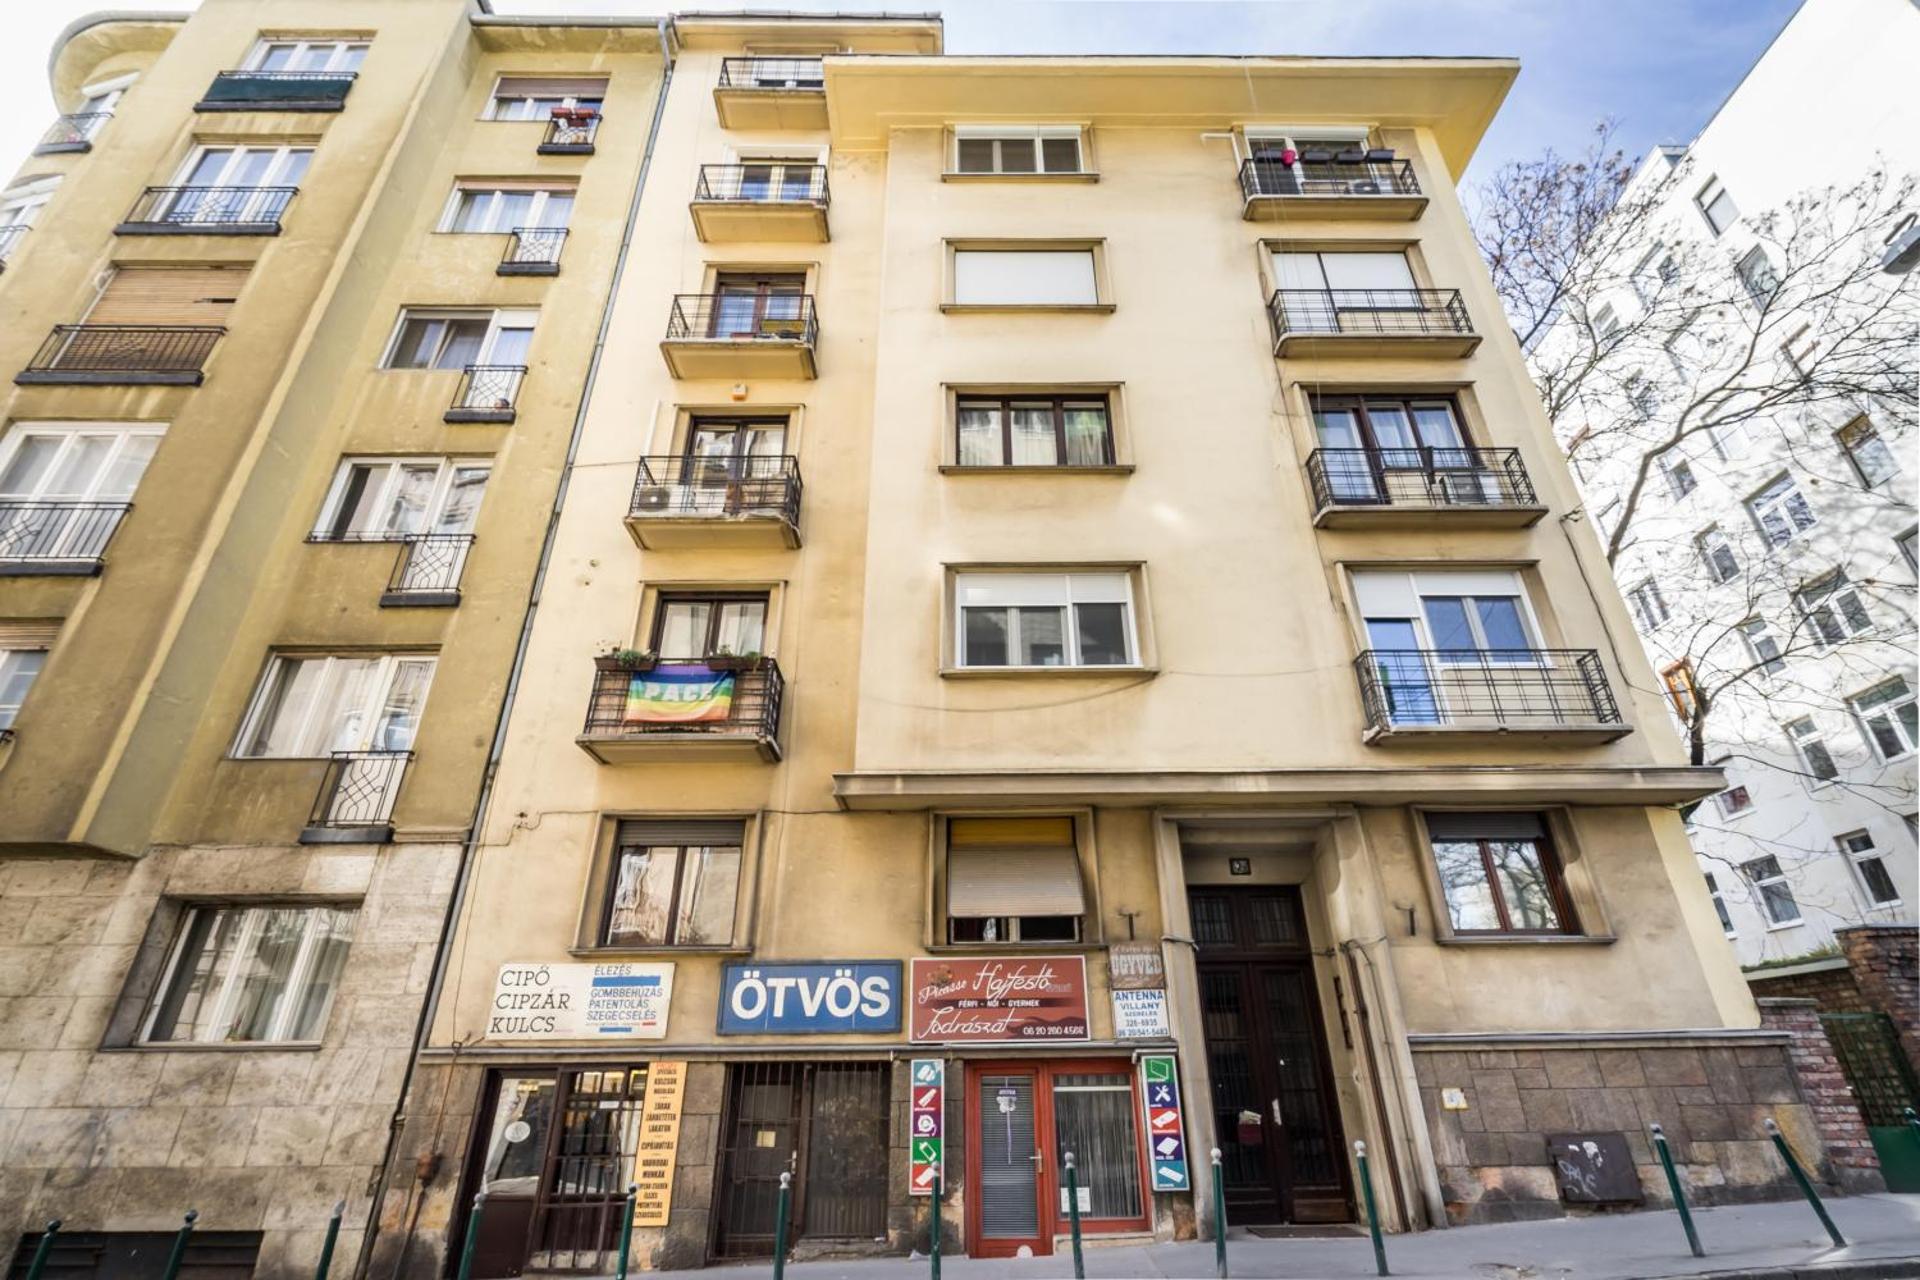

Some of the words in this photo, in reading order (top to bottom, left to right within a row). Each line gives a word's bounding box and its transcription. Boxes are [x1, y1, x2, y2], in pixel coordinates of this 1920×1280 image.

[500, 966, 551, 987] CIPŐ
[496, 987, 571, 1011] CIPZÁR
[731, 969, 891, 1020] ÖTVÖS
[1115, 991, 1163, 1001] ANTENNA
[490, 1015, 556, 1034] KULCS
